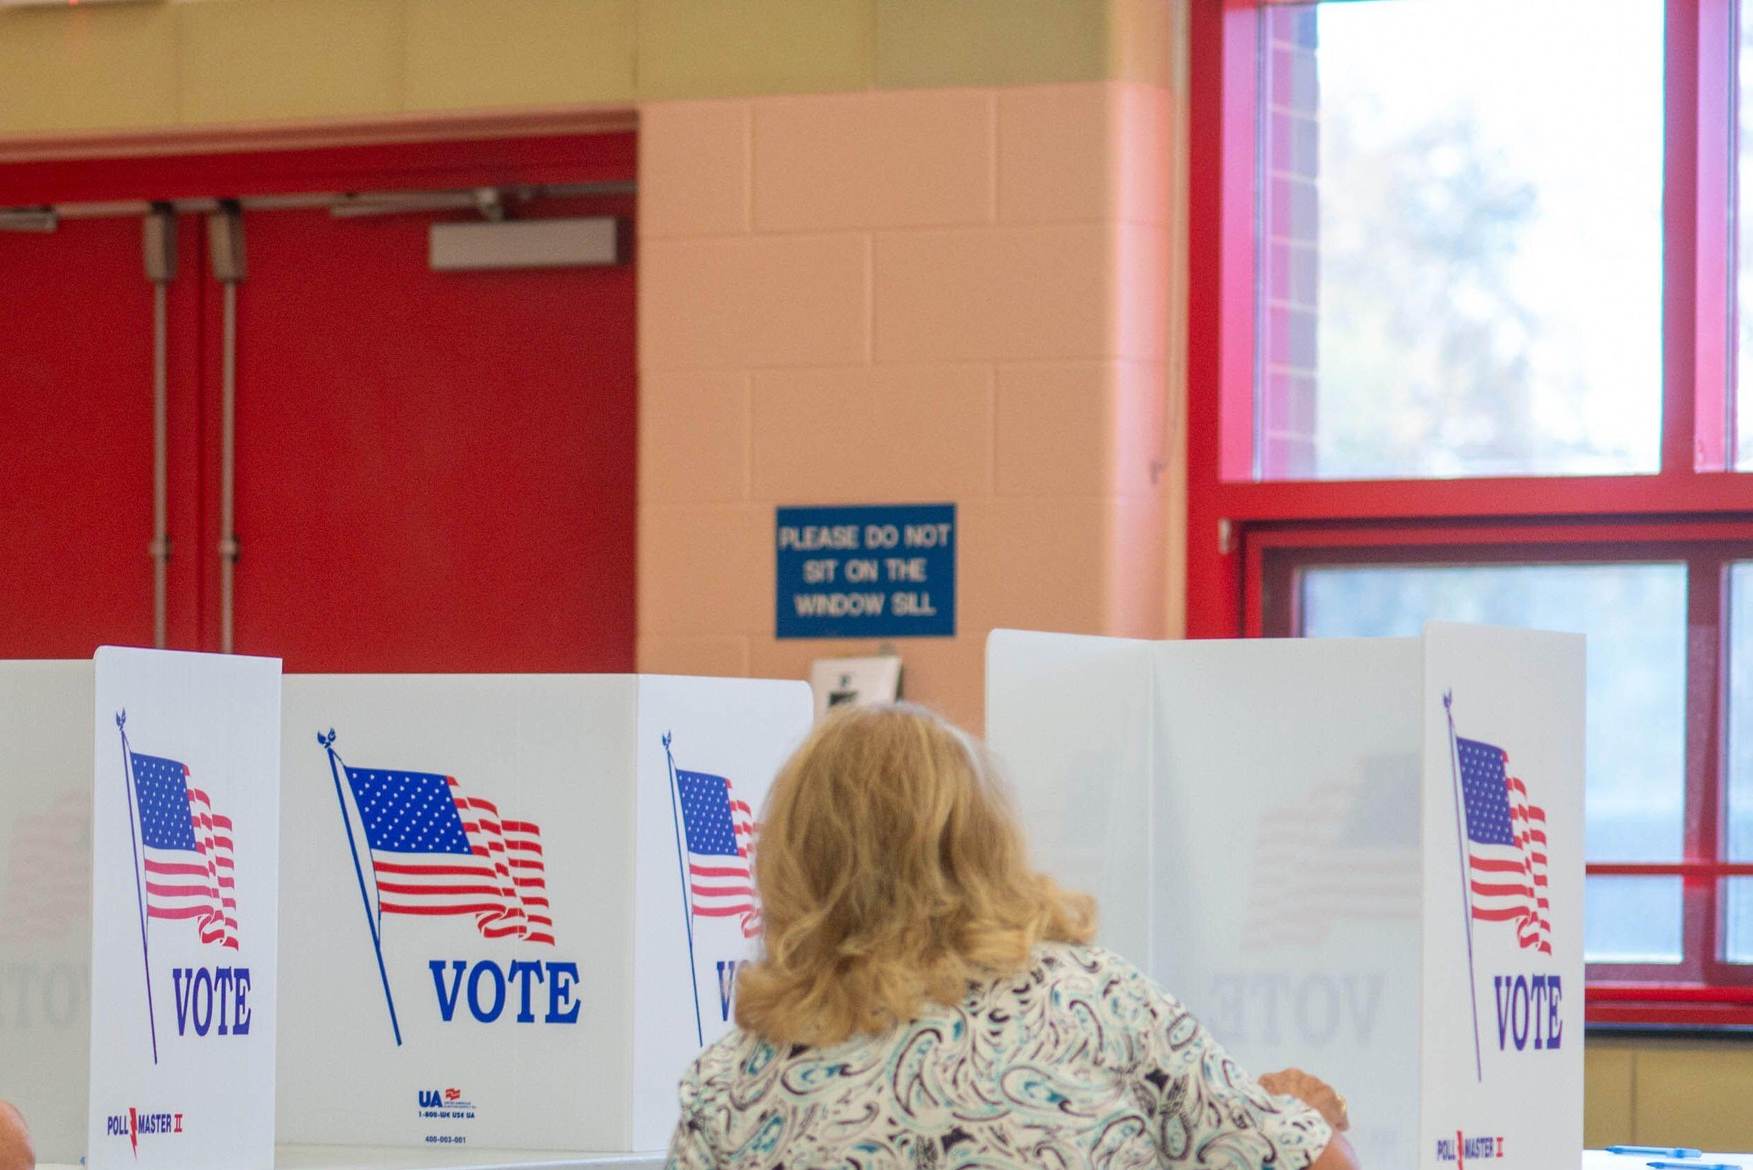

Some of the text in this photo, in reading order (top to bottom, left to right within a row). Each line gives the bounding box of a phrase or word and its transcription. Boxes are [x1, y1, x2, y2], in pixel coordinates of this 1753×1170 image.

[779, 524, 950, 548] PLEASE DO NOT
[804, 559, 926, 583] SIT ON THE
[795, 592, 935, 616] WINDOW SILL
[172, 966, 252, 1037] VOTE
[429, 959, 581, 1024] VOTE
[1493, 973, 1563, 1052] VOTE
[418, 1090, 443, 1108] UA
[107, 1116, 129, 1136] POLL
[138, 1114, 172, 1134] MASTER
[1437, 1139, 1456, 1160] POLL
[1465, 1137, 1494, 1159] MASTER
